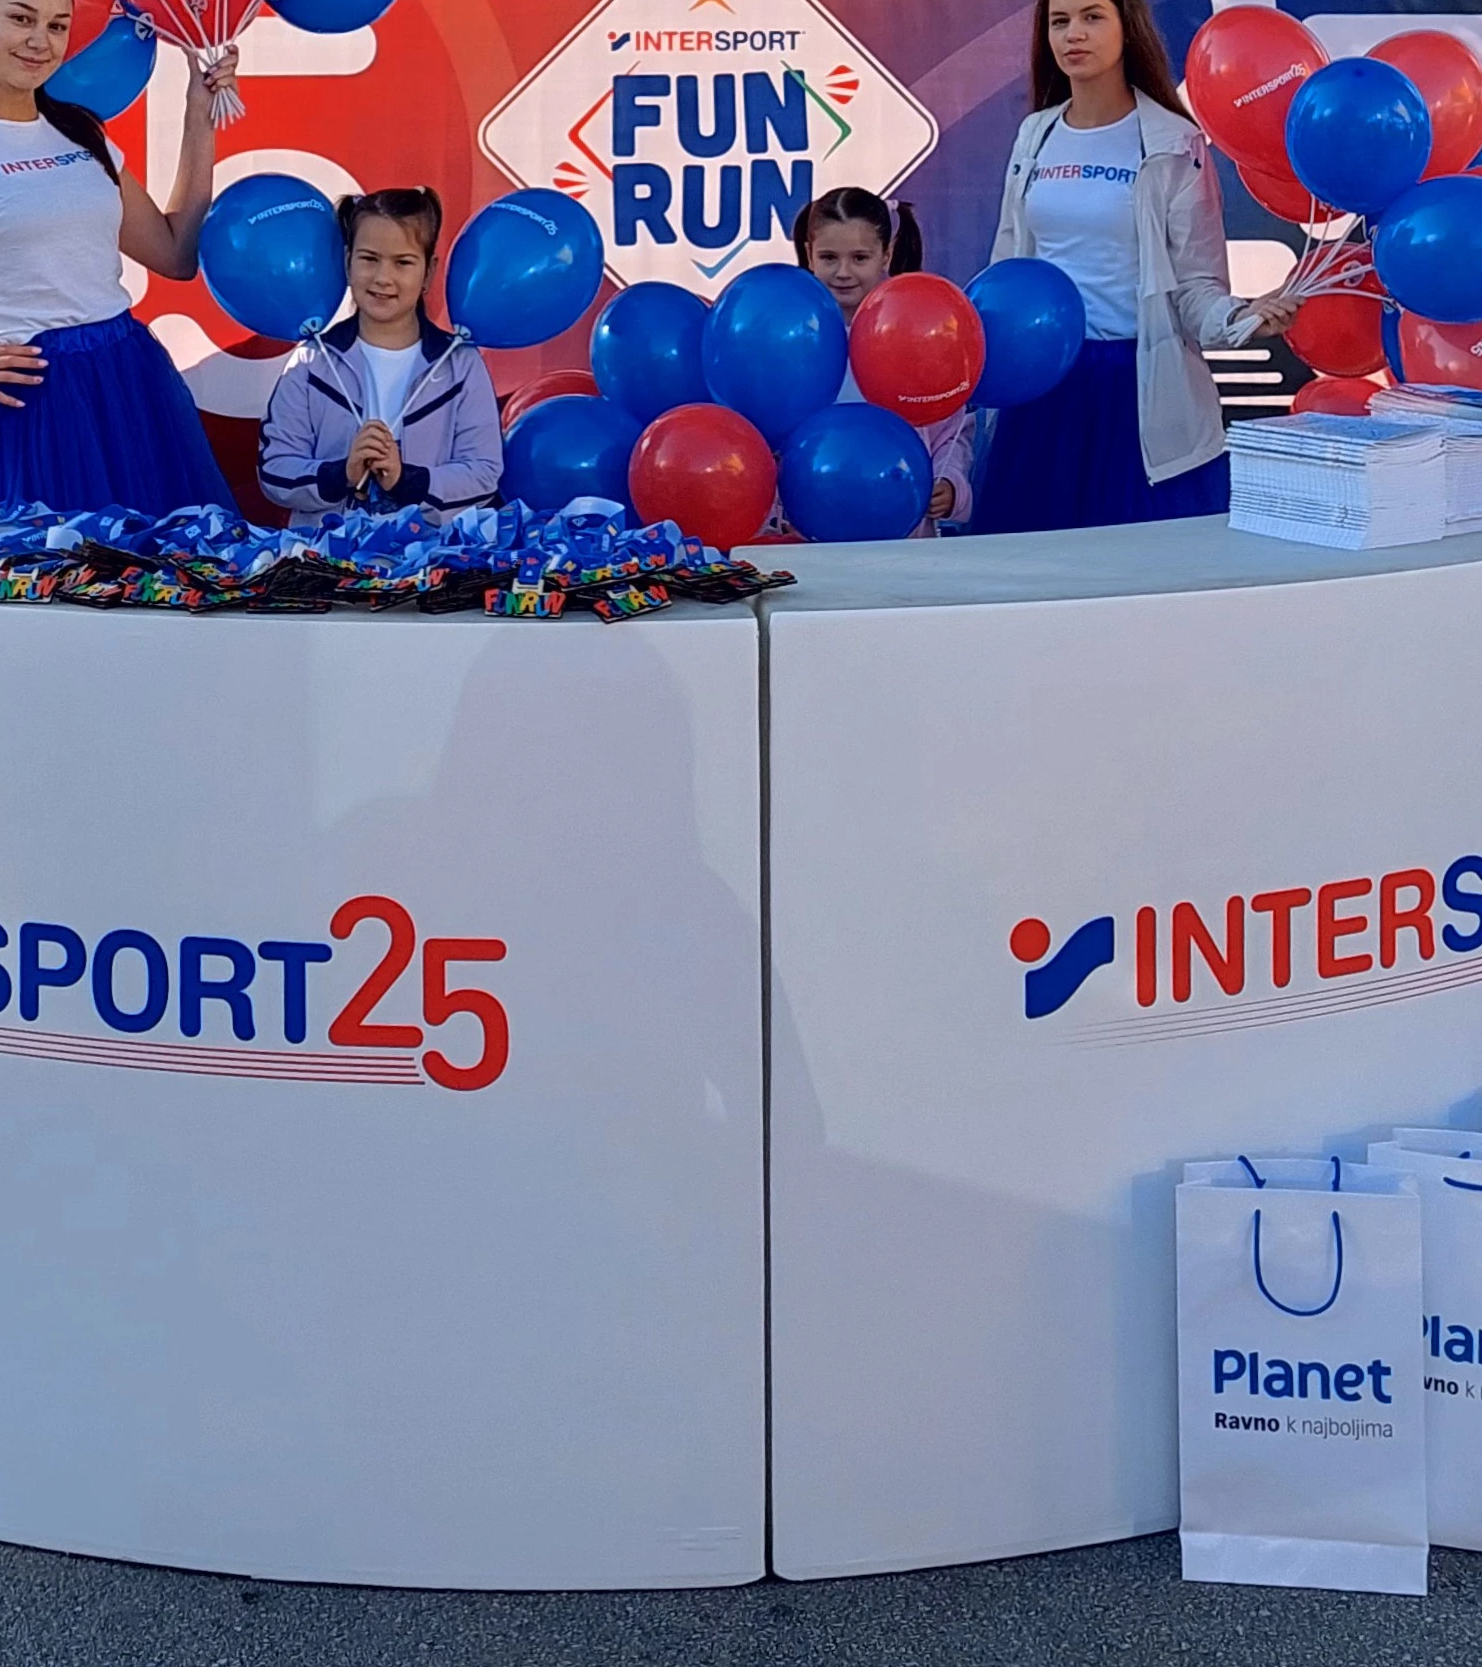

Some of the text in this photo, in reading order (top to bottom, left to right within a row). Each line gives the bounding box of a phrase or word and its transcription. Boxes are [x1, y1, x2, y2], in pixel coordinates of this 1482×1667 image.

[634, 30, 802, 52] INTERSPORT
[612, 69, 809, 159] FUN
[612, 159, 814, 250] RUN
[1213, 1348, 1393, 1404] Planet
[1464, 1380, 1476, 1399] k
[1214, 1411, 1394, 1440] Ravno k najboljima
